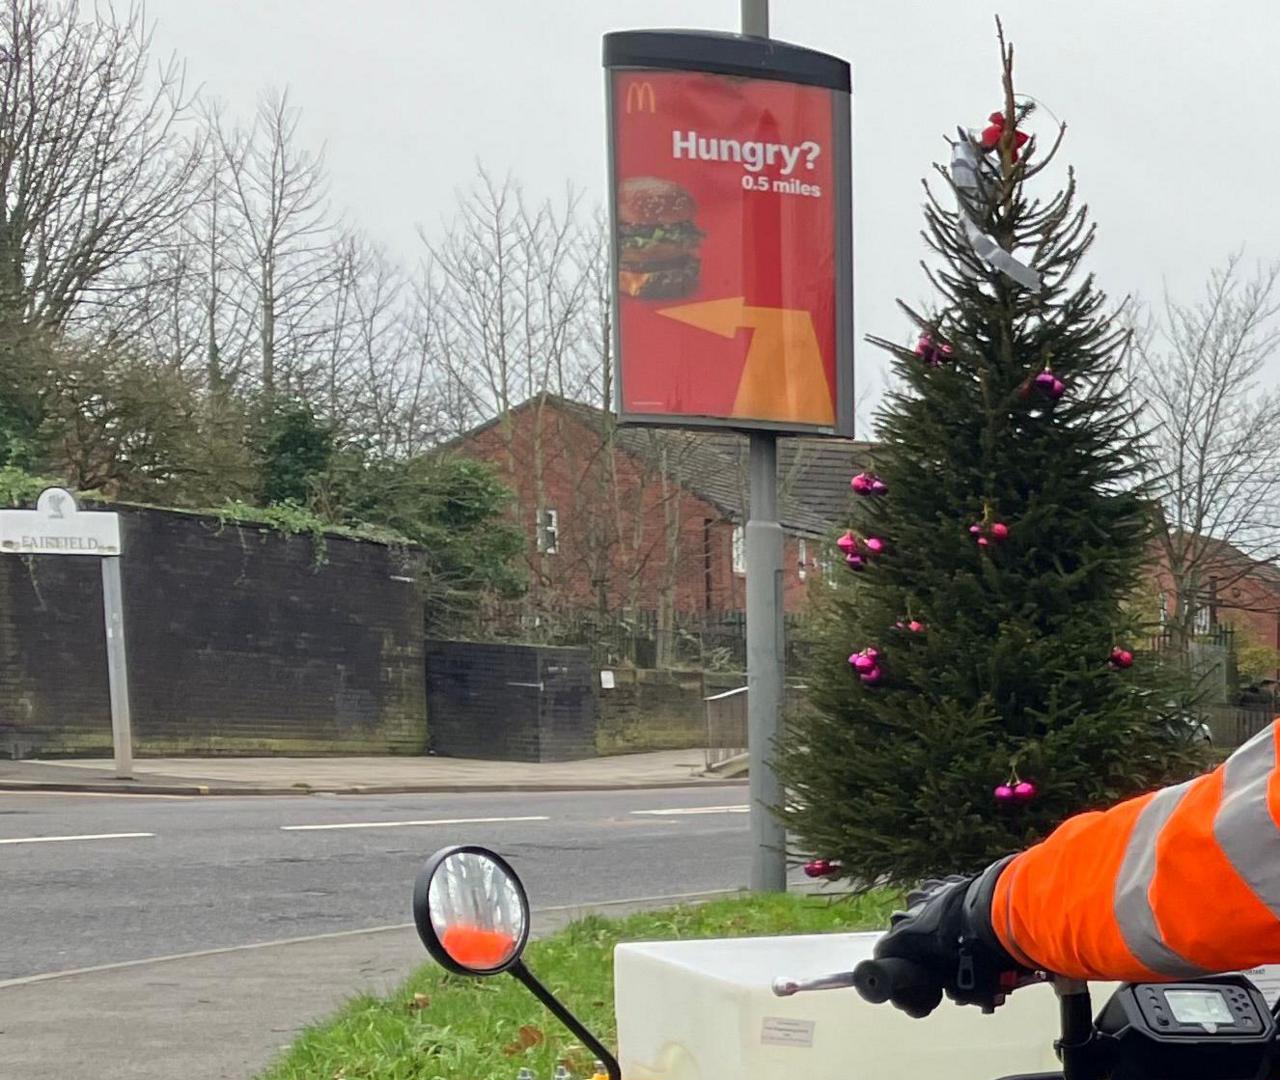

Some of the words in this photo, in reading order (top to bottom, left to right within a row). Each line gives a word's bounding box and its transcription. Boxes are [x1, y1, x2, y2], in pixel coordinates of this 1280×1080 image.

[672, 130, 821, 175] Hungry?
[741, 175, 769, 191] 0.5
[773, 178, 821, 198] miles
